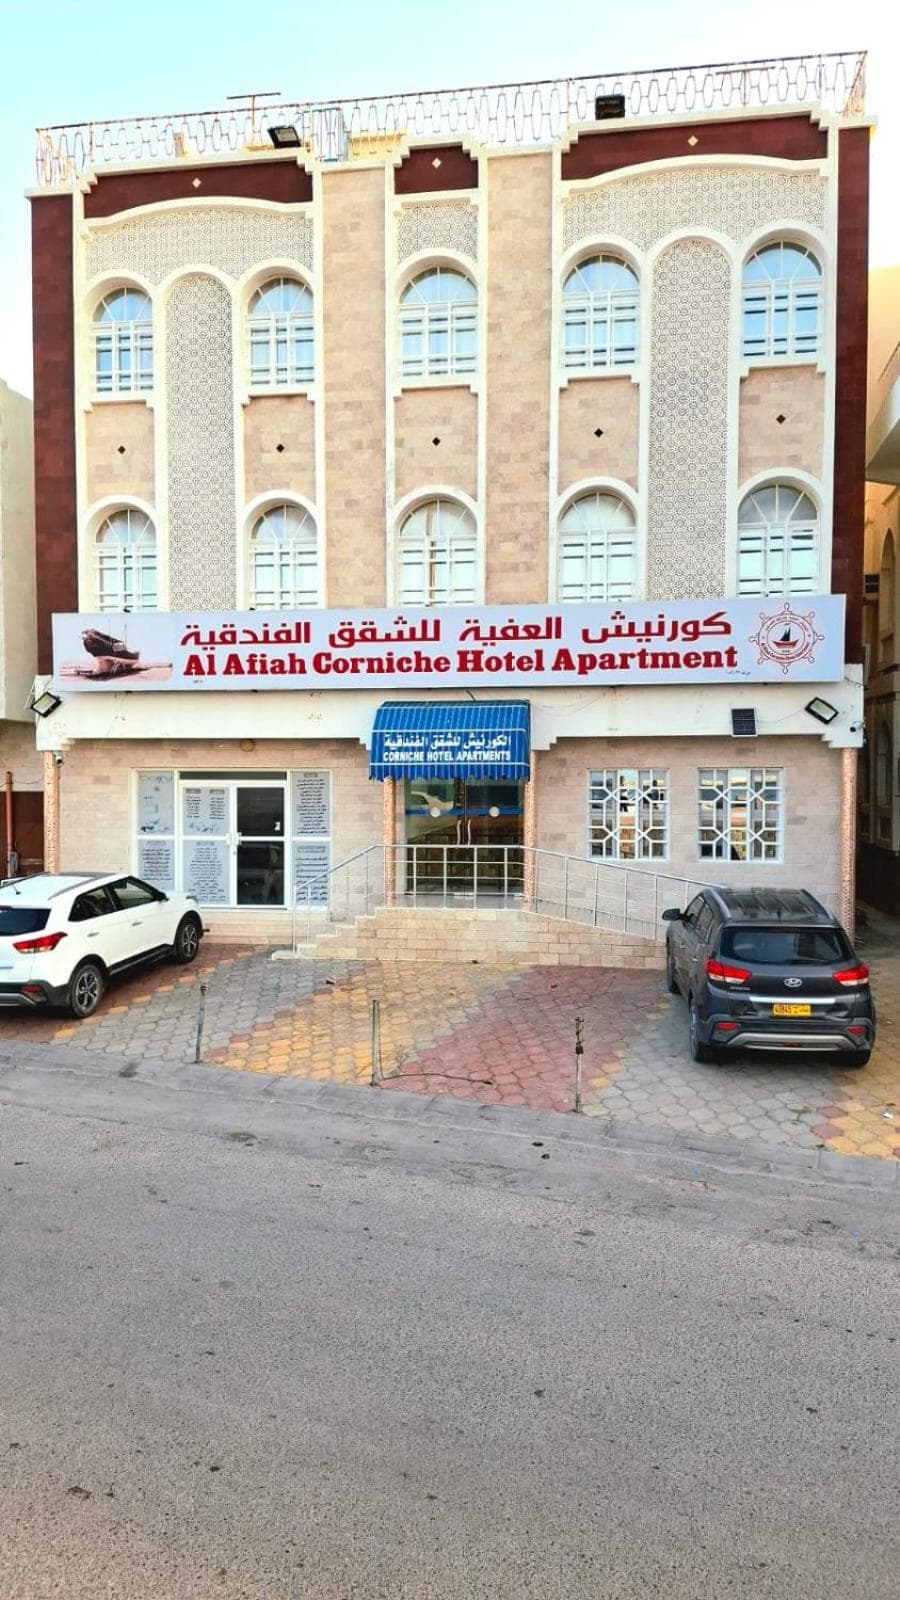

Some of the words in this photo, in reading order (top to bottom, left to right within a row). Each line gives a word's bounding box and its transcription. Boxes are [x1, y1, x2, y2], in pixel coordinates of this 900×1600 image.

[180, 621, 311, 652] الفندقية
[328, 616, 441, 649] للشقق
[458, 616, 562, 647] العفية
[582, 611, 732, 643] كورنيش
[183, 653, 217, 677] Al
[222, 652, 307, 677] Afiah
[312, 650, 450, 676] Corniche
[456, 648, 545, 674] Hotel
[552, 645, 738, 675] Apartment
[383, 734, 429, 750] الفندقية
[383, 751, 424, 762] CORNICHE
[427, 751, 454, 761] HOTEL
[456, 750, 511, 761] APARTMENTS
[431, 732, 461, 750] للشقق
[463, 732, 511, 749] الكورنيش
